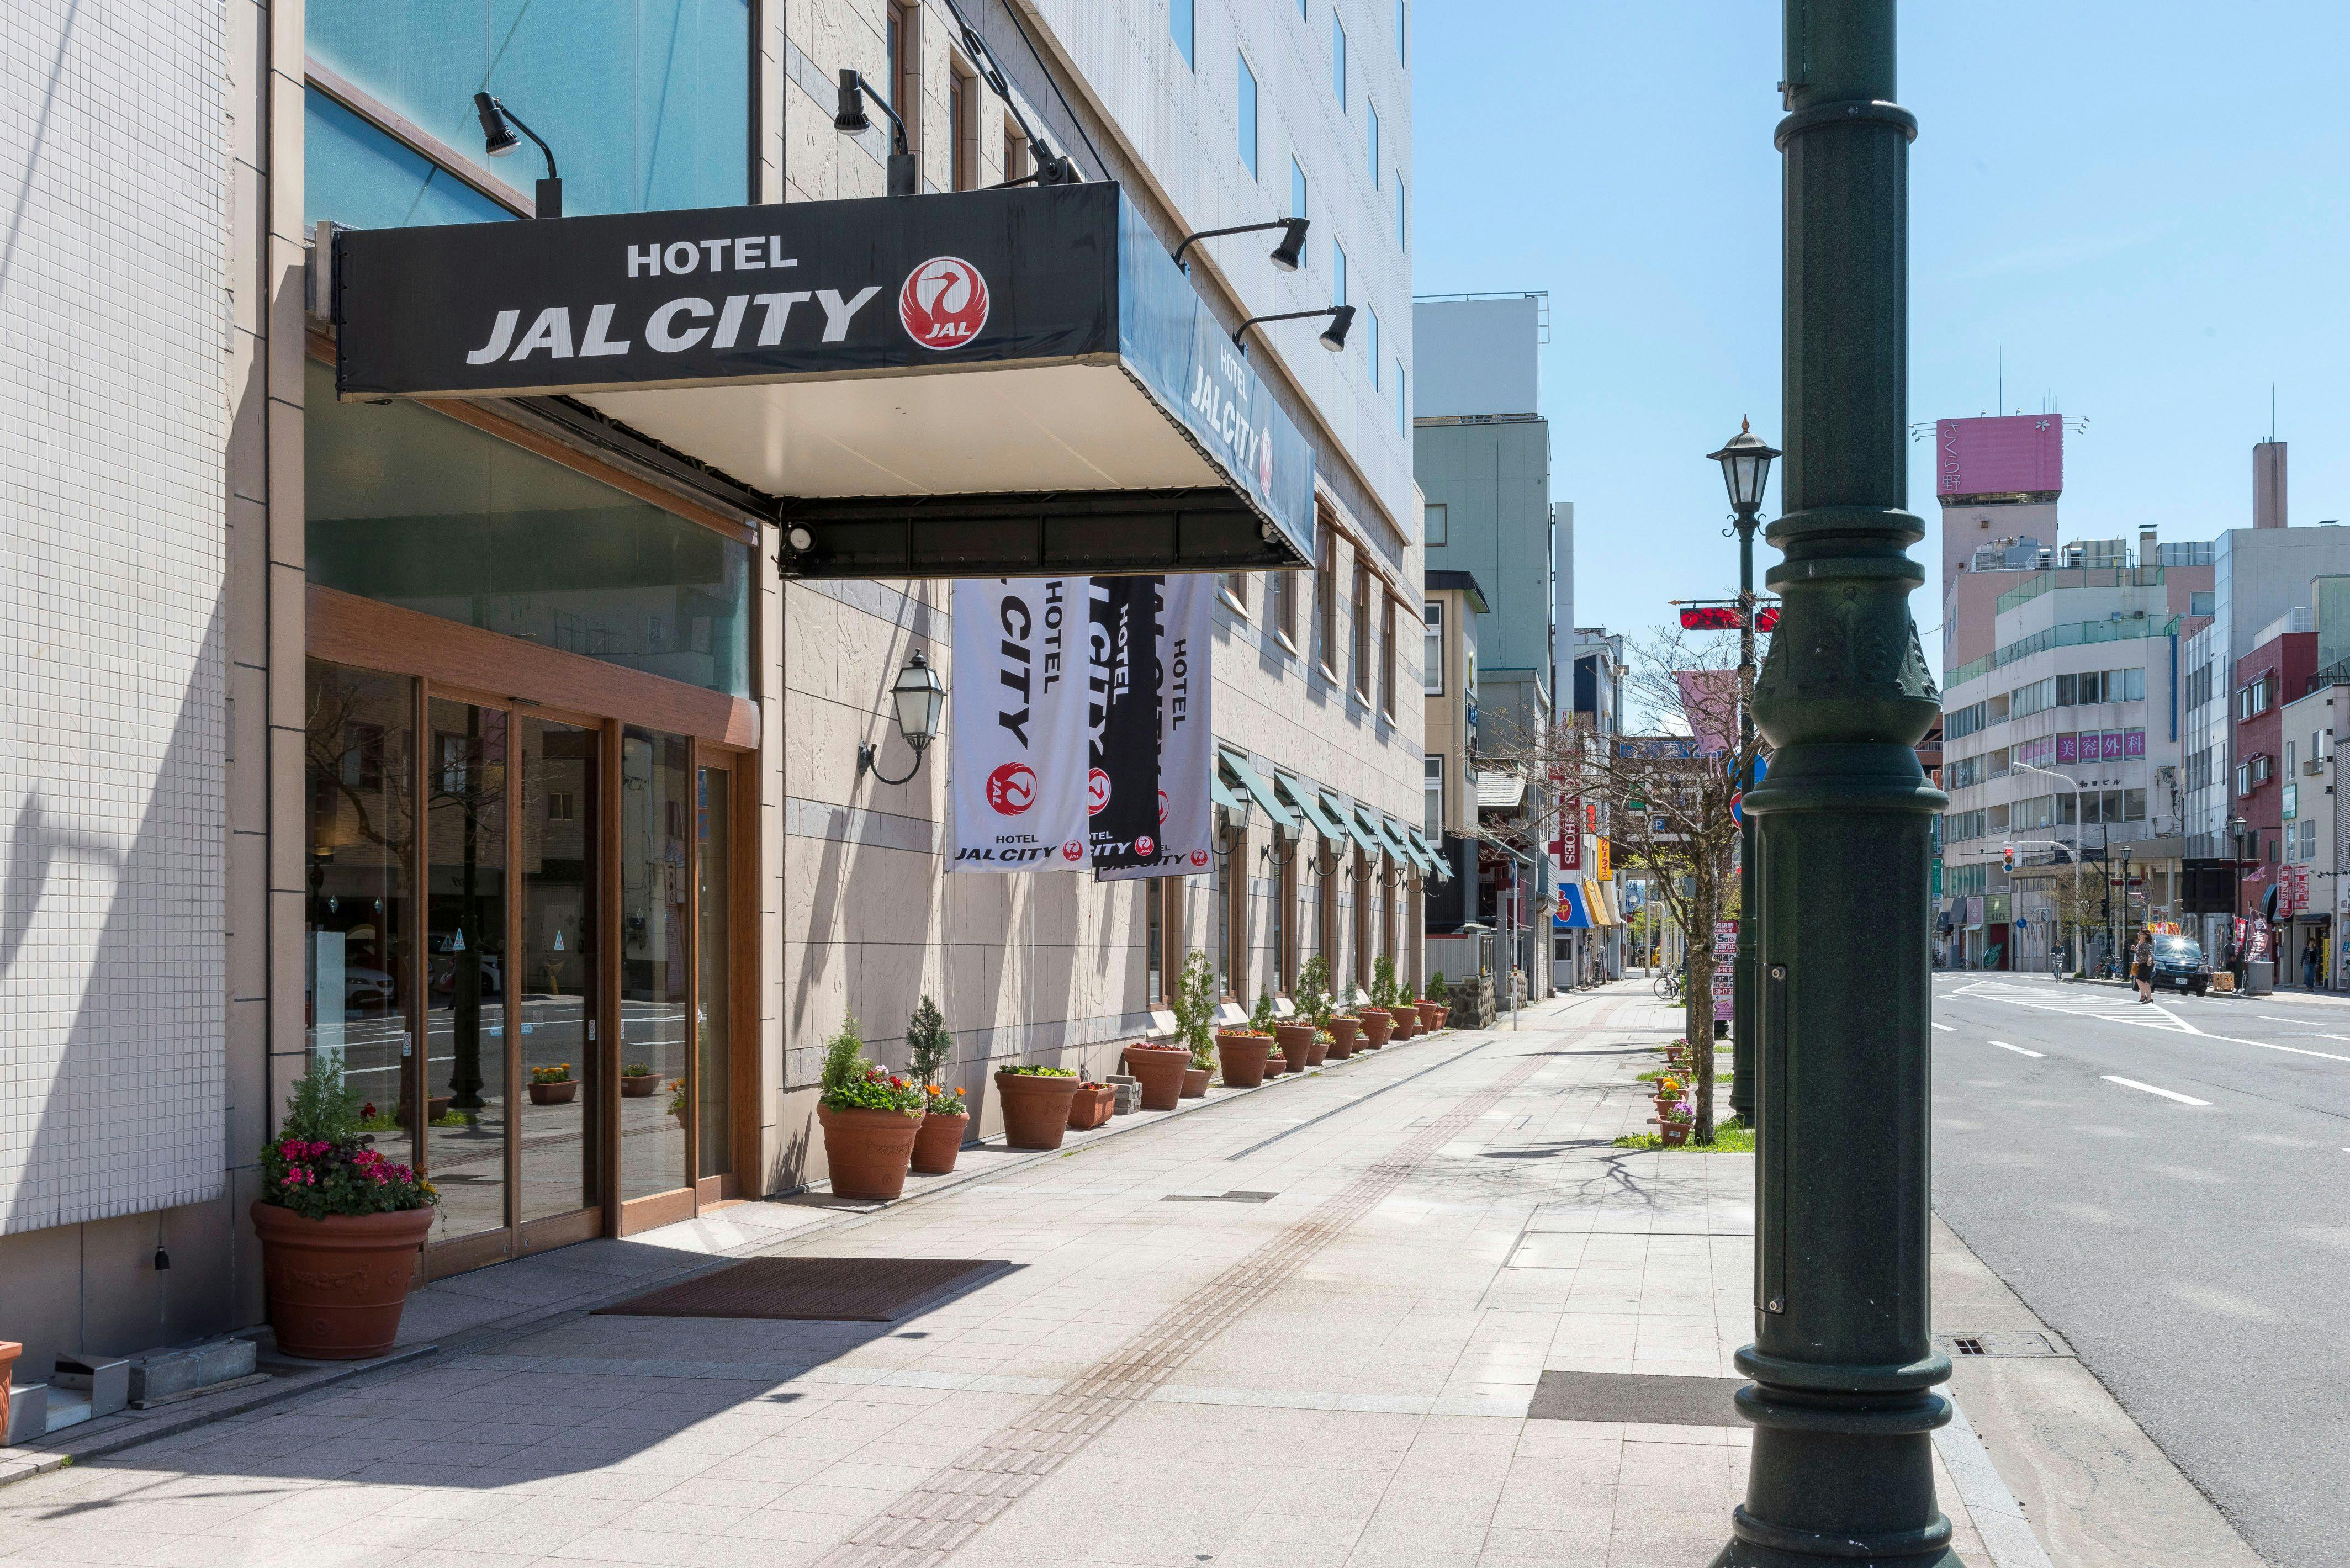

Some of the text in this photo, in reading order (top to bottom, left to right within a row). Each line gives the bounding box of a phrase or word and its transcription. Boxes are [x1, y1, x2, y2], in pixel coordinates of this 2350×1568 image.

[628, 235, 797, 277] HOTEL
[465, 286, 883, 364] JAL CITY
[925, 321, 971, 338] JAL
[1221, 343, 1247, 402] HOTEL
[1190, 365, 1259, 470] JAL CITY
[1943, 421, 1961, 492] さくら野
[1044, 581, 1063, 695] HOTEL
[1113, 603, 1128, 705] HOTEL
[999, 595, 1031, 750] CITY
[1173, 639, 1187, 731] HOTEL
[2060, 735, 2142, 757] 美容外科
[992, 777, 1002, 806] JAL
[955, 846, 1058, 861] JAL CITY
[996, 834, 1039, 844] HOTEL
[1089, 831, 1113, 840] TEL
